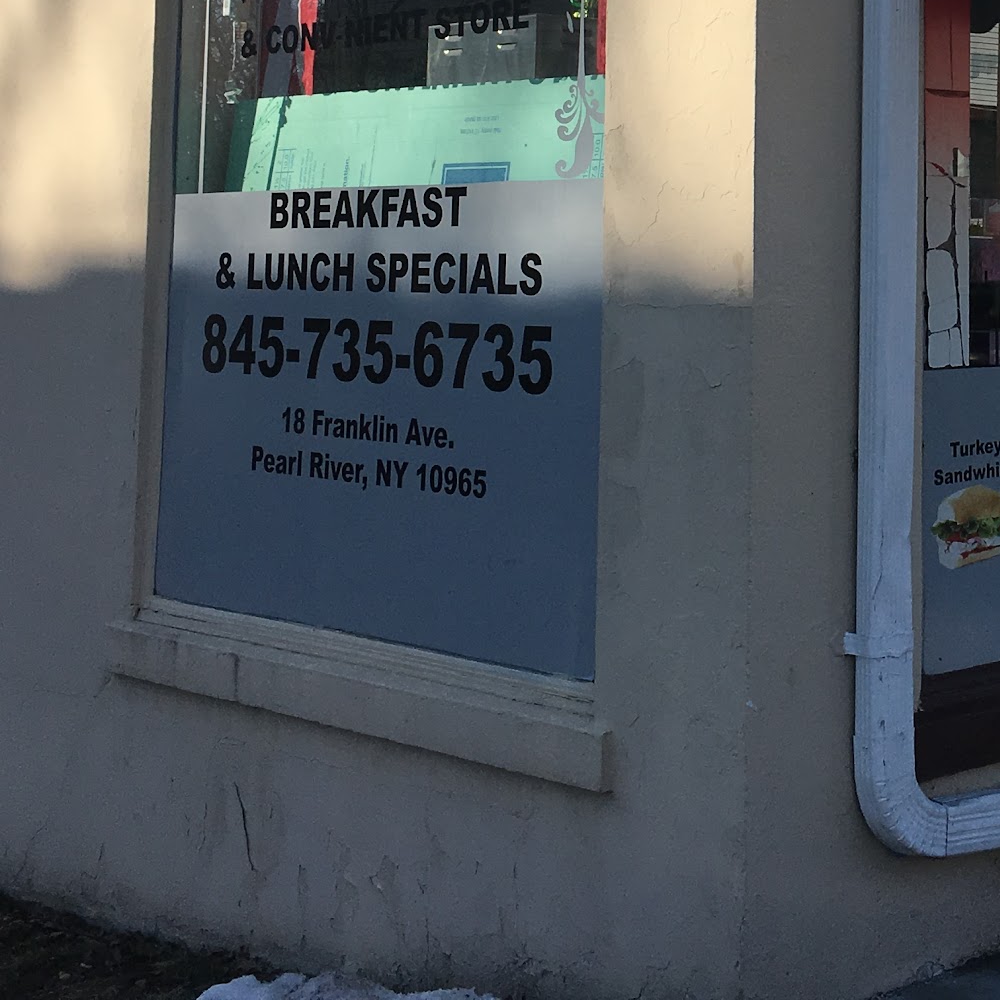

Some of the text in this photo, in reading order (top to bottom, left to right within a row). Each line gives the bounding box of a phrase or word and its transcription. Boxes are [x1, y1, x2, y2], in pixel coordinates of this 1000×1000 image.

[241, 29, 257, 58] &
[269, 186, 467, 229] BREAKFAST
[215, 252, 542, 296] & LUNCH SPECIALS
[202, 314, 553, 395] 845-735-6735
[281, 407, 454, 449] 18 Franklin Ave.
[251, 445, 487, 499] Pearl River, NY 10965
